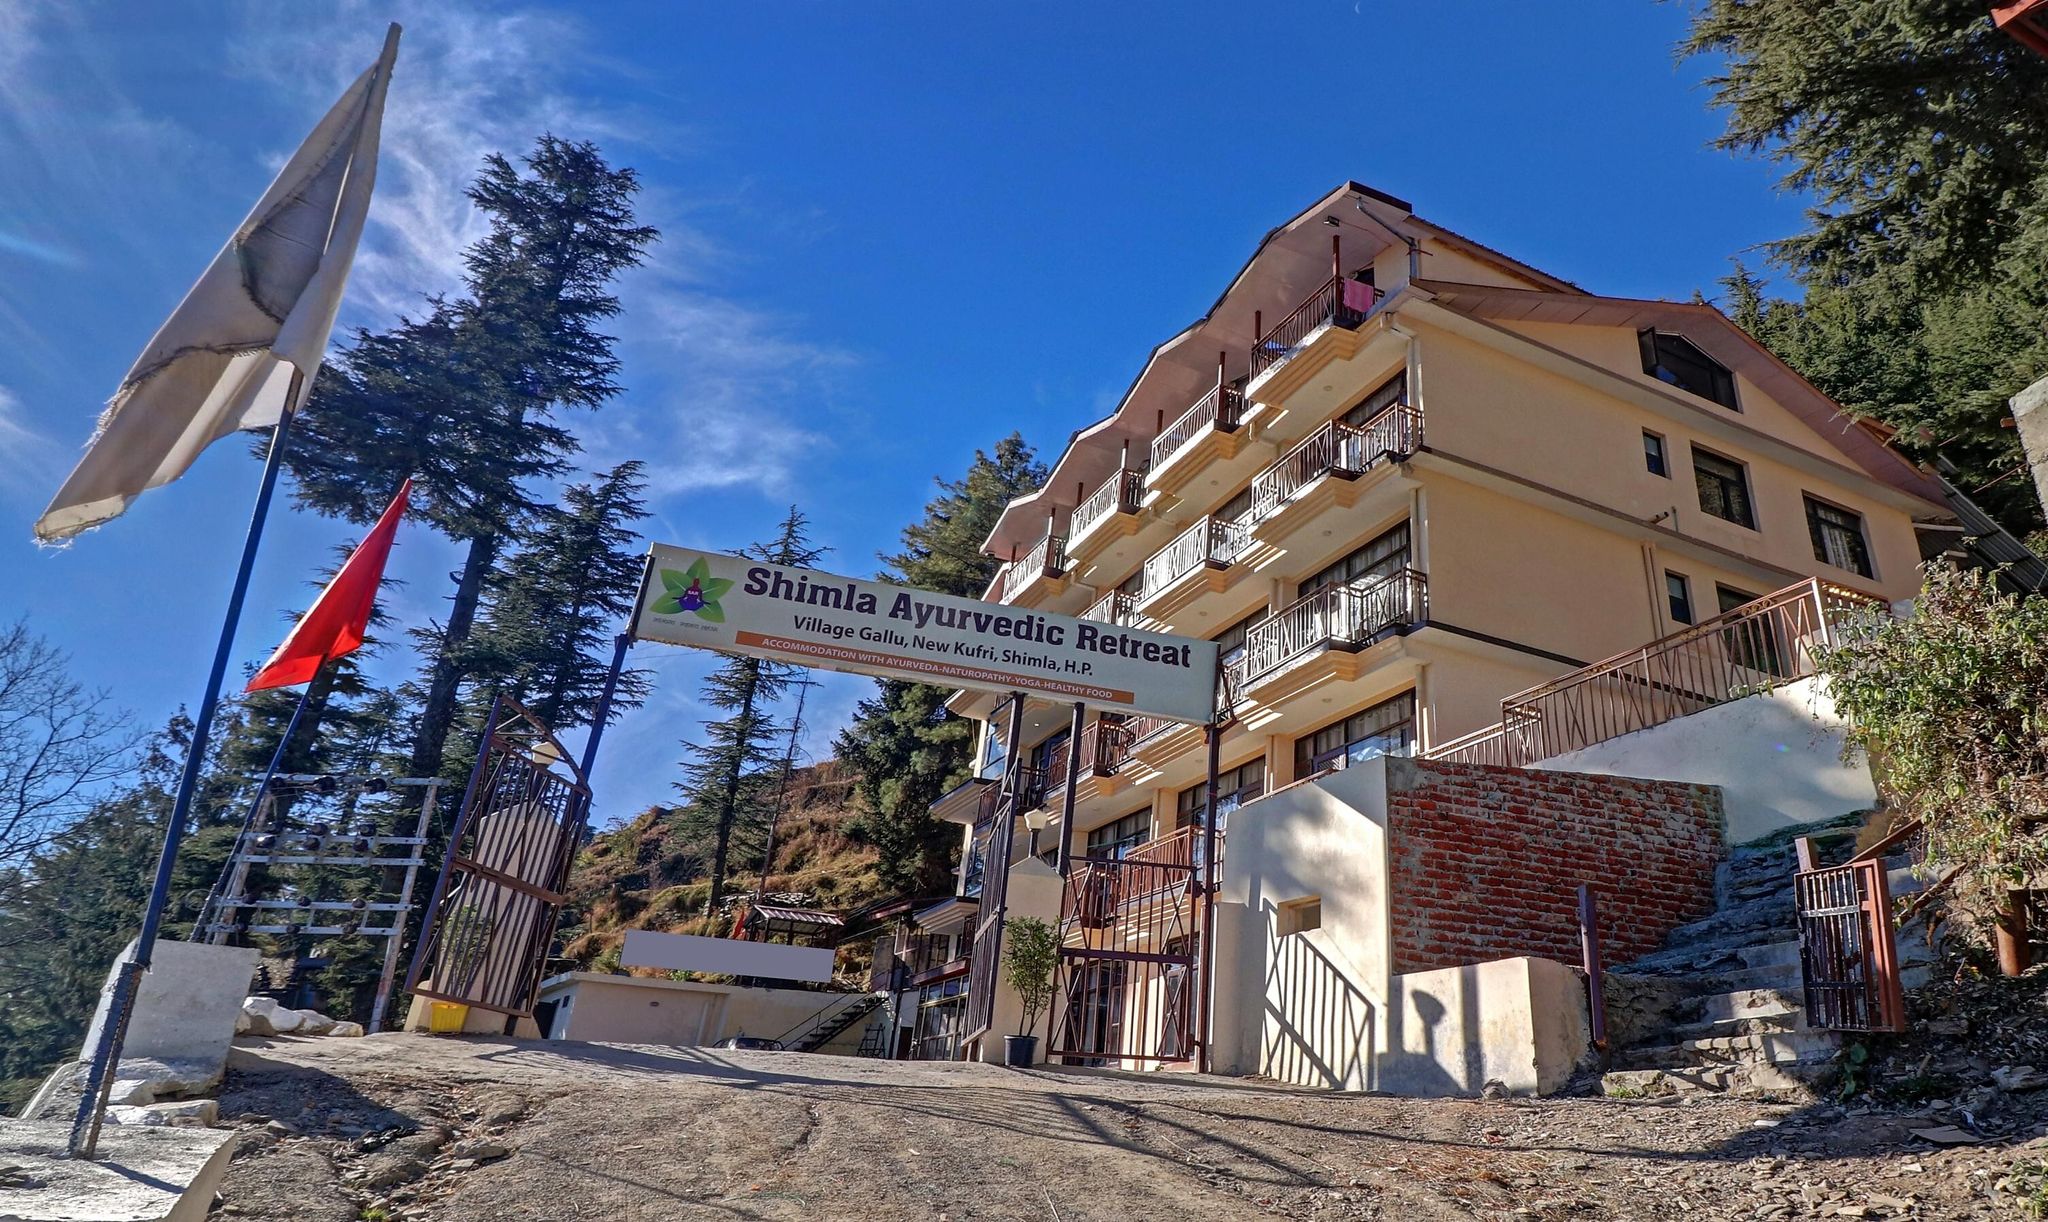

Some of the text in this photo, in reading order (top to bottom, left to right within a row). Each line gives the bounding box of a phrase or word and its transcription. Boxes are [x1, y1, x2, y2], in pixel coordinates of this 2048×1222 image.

[744, 567, 1191, 668] Shimla Ayurvedic Retreat
[794, 615, 1093, 676] Village Gallu, New Kufri, Shimla, H.P.
[761, 638, 857, 660] ACCOMMODATION
[858, 653, 885, 664] WITH
[1086, 687, 1113, 699] FOOD
